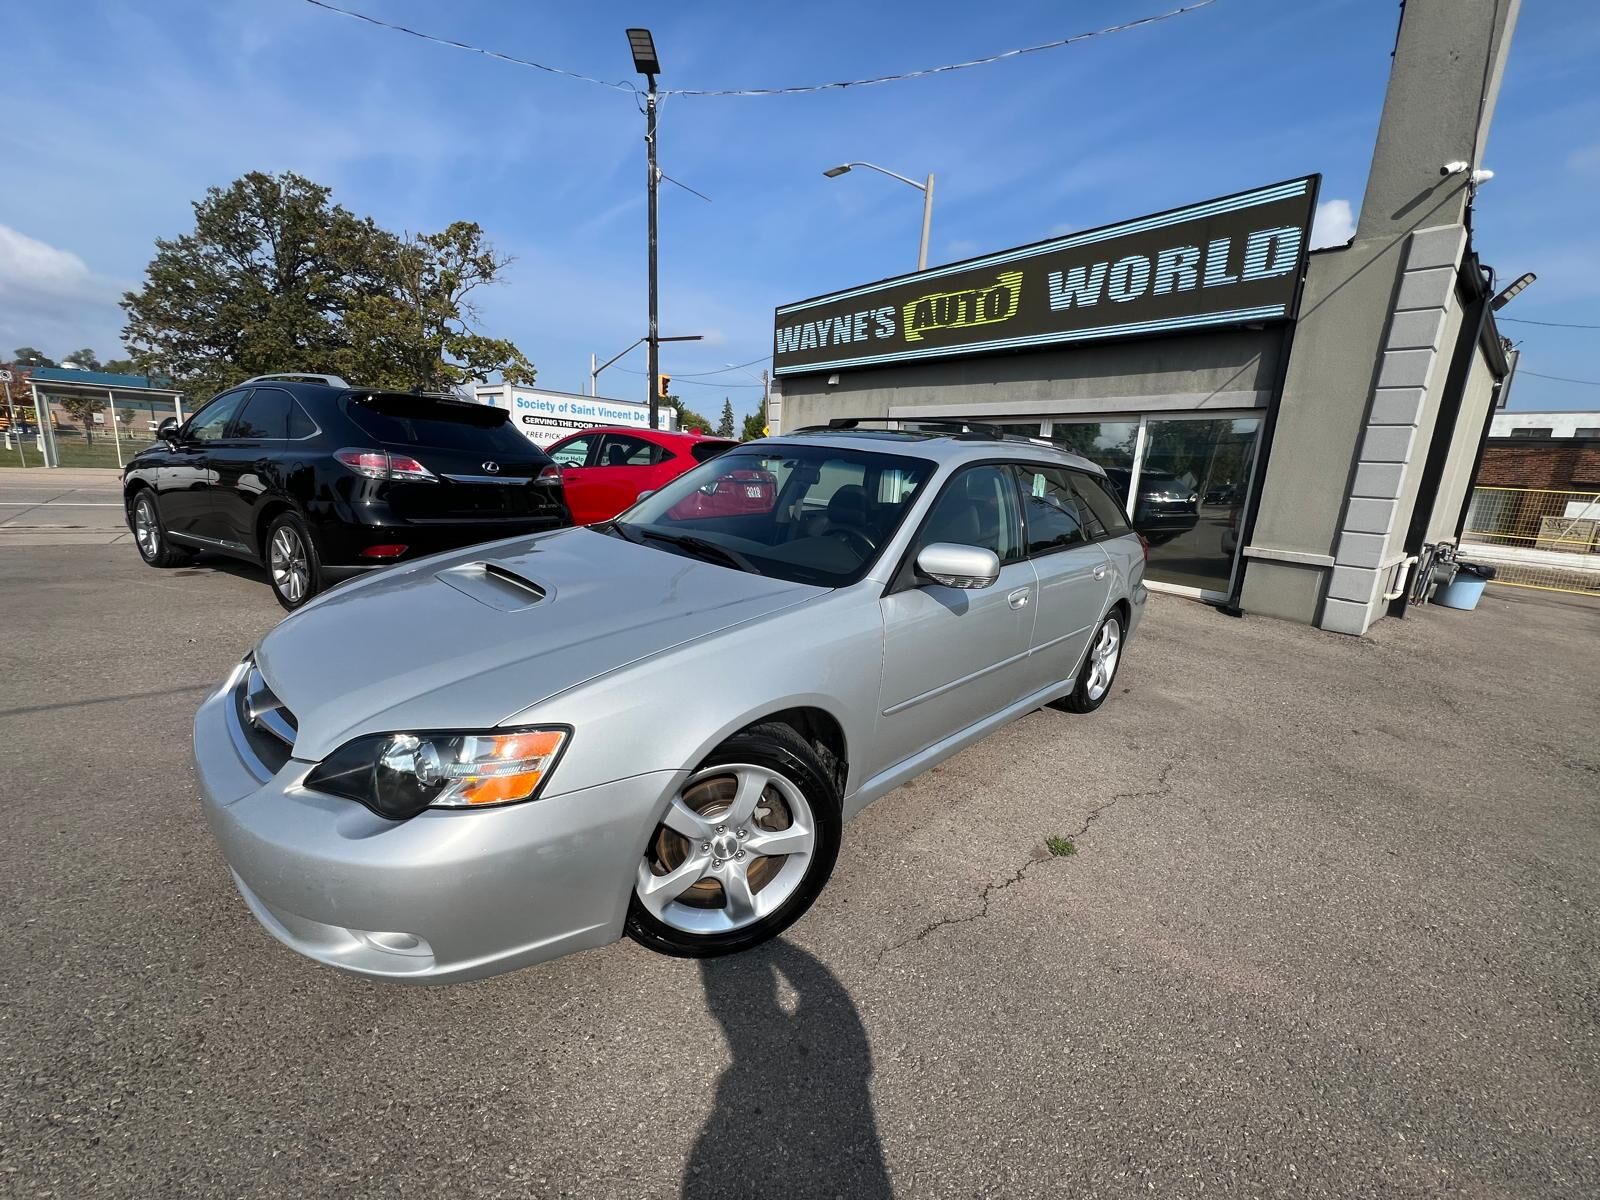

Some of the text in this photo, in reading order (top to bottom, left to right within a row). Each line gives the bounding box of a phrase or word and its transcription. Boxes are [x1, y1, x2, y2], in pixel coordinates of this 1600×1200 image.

[776, 225, 1302, 354] WAYNE'S AUTO WORLD
[516, 397, 555, 413] Society
[558, 402, 568, 412] of
[570, 403, 595, 416] Saint
[598, 407, 631, 420] Vincent
[633, 411, 645, 421] De
[525, 416, 558, 426] SERVING
[559, 420, 573, 428] THE
[525, 430, 544, 438] FREE
